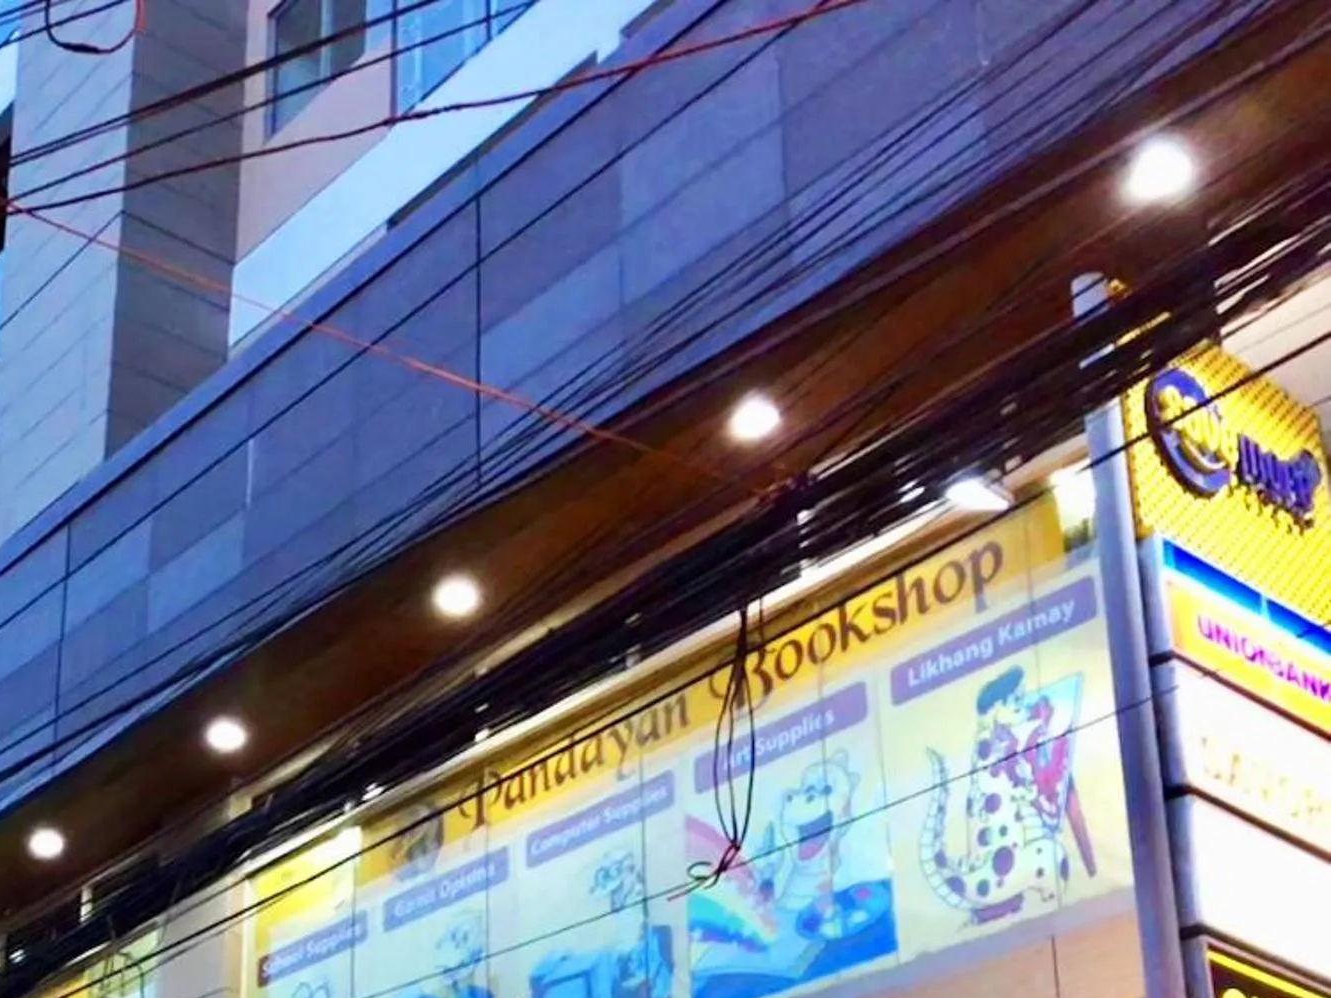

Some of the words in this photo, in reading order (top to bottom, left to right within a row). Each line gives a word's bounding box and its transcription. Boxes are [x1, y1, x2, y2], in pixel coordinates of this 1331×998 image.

[907, 633, 995, 688] Likhang
[997, 599, 1075, 647] Karnay
[457, 690, 691, 831] Pandayan
[709, 540, 1003, 709] Bookshop
[755, 709, 836, 756] Supplies
[531, 812, 601, 855] Computer
